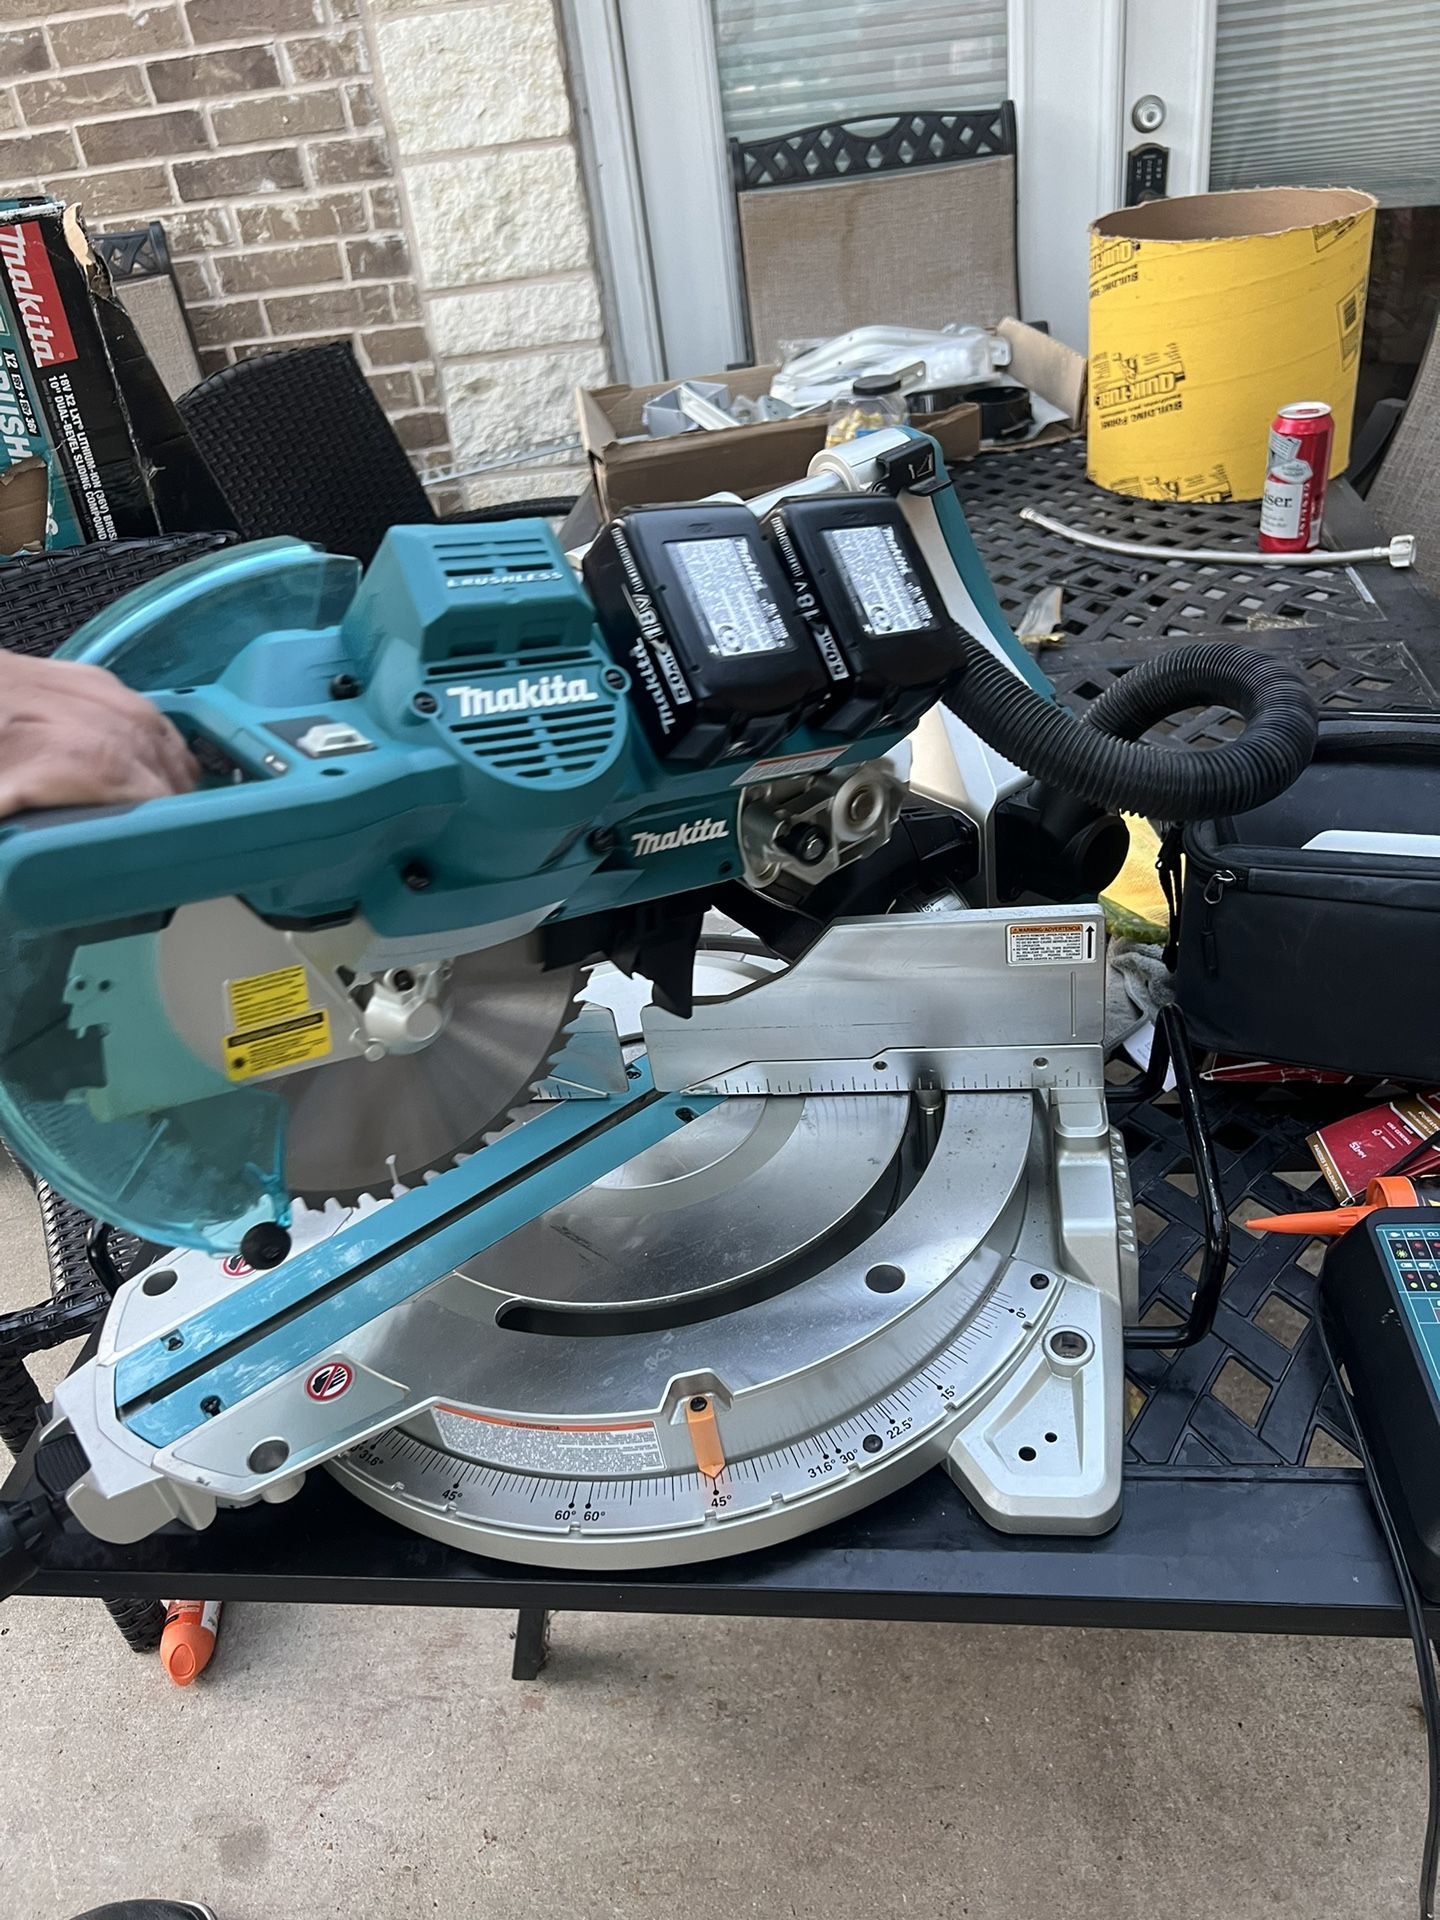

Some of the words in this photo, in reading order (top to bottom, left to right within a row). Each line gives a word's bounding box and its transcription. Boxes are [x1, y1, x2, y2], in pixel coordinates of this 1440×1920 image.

[59, 372, 72, 392] 18V
[64, 393, 76, 407] X2
[54, 395, 80, 453] DUAL-BEVEL
[73, 454, 92, 491] SLIDING
[85, 491, 107, 540] COMPOUND
[77, 431, 102, 488] LITHIUM-ION
[93, 490, 109, 514] (36V)
[103, 514, 118, 541] BRUS
[1015, 1307, 1025, 1319] 0°
[940, 1385, 956, 1401] 15°
[886, 1417, 913, 1440] 22.5°
[359, 1449, 384, 1466] 31.6°
[839, 1448, 858, 1465] 30°
[807, 1458, 836, 1479] 31.6°
[442, 1489, 463, 1501] 45°
[711, 1495, 732, 1508] 45°
[554, 1510, 576, 1521] 60°
[583, 1510, 605, 1522] 60°
